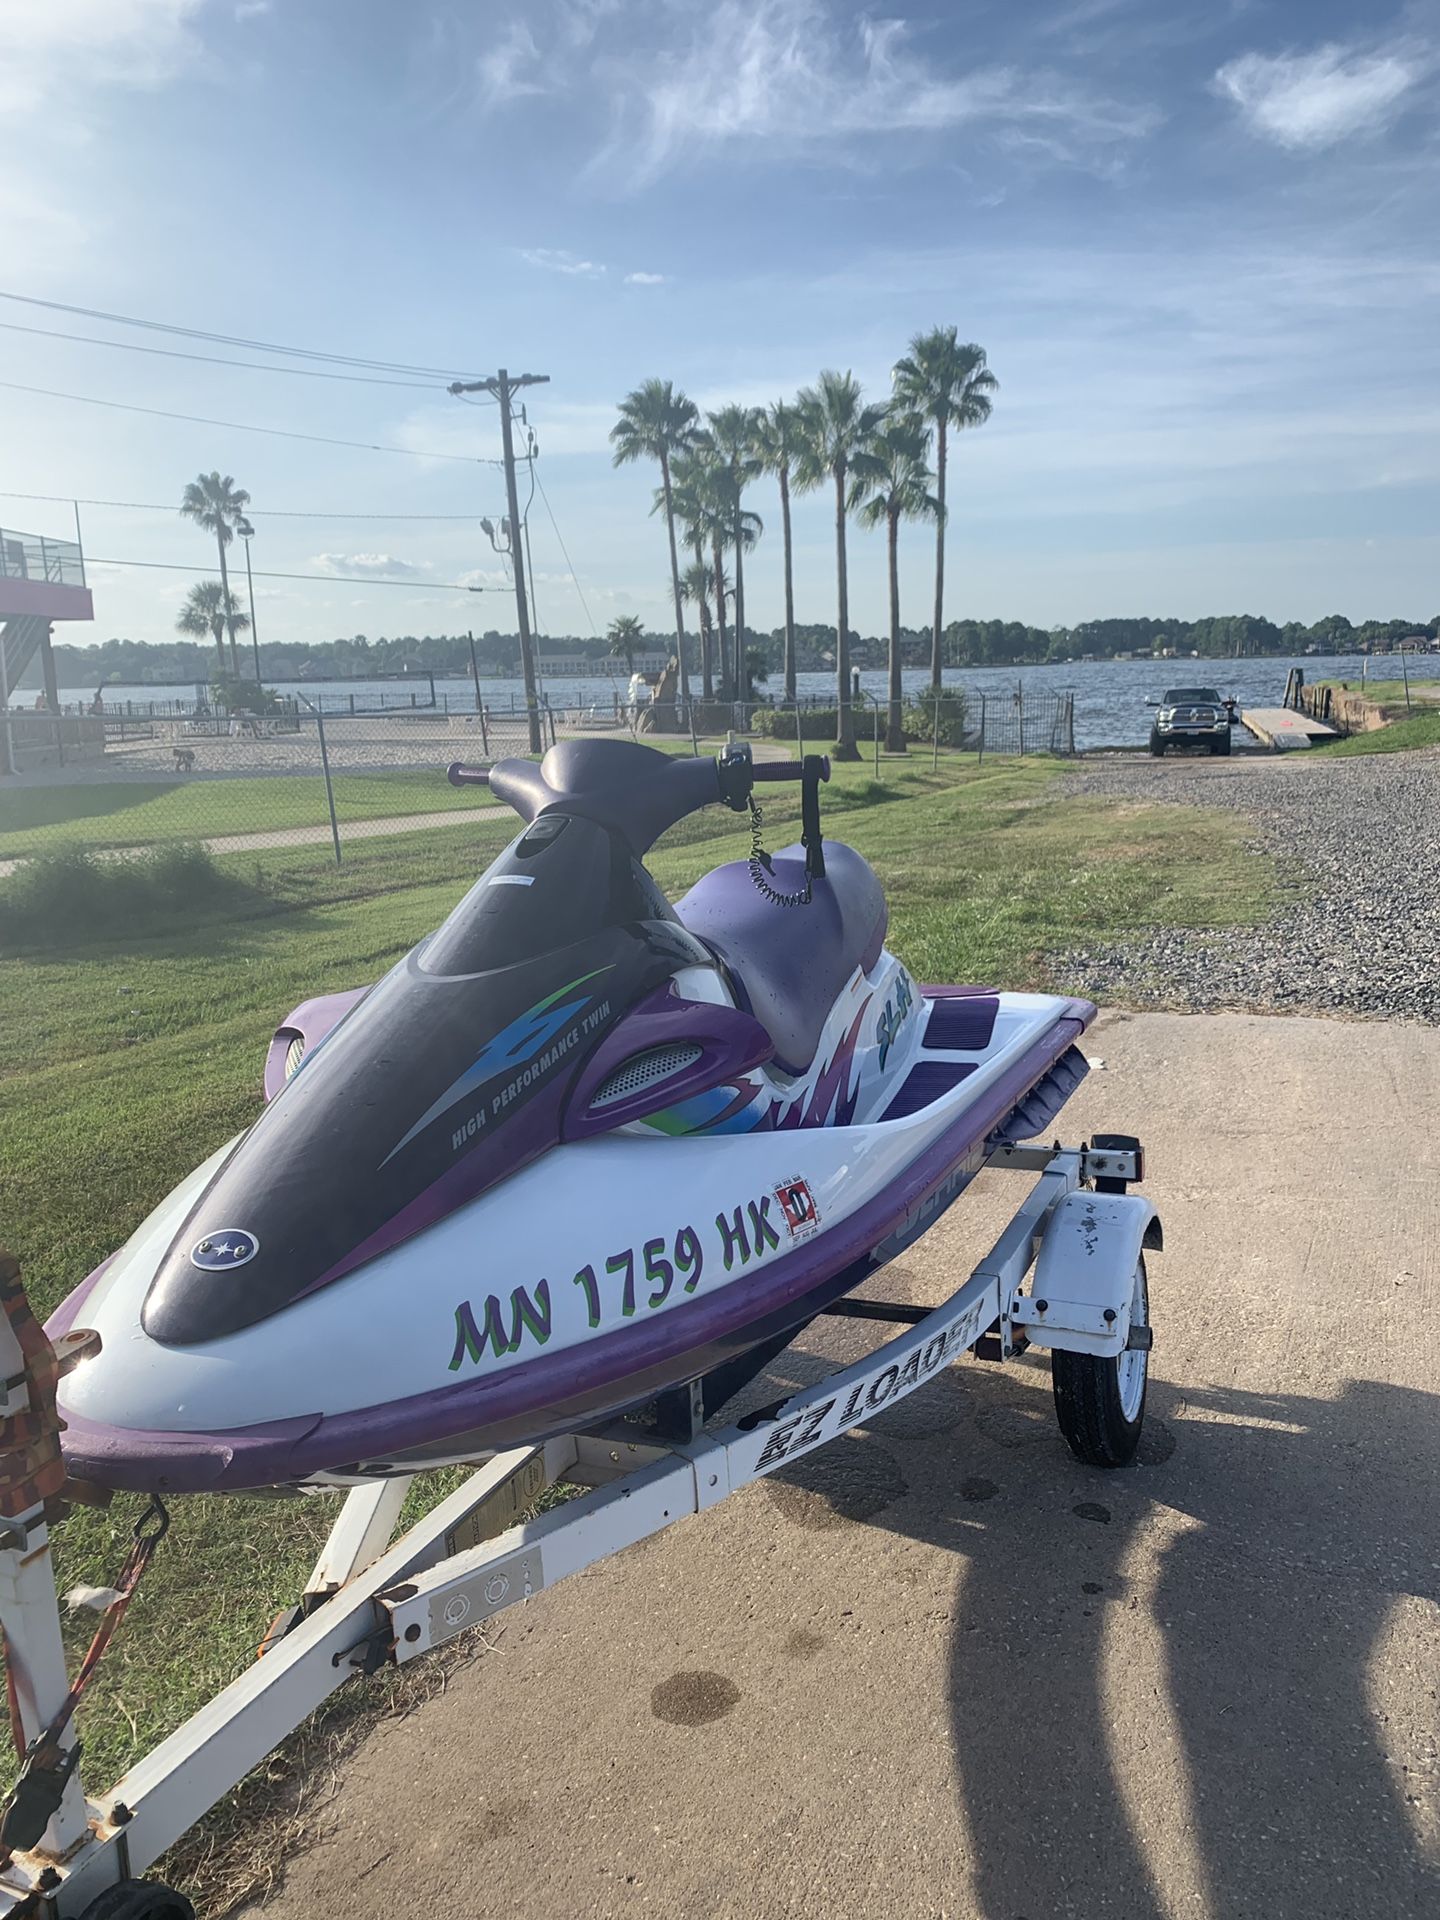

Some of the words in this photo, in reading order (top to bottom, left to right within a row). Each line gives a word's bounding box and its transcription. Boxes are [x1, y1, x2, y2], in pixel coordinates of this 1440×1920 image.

[452, 1109, 487, 1151] HIGH
[492, 1028, 580, 1115] PERFORMANCE
[581, 1000, 611, 1035] TWIN
[448, 1279, 552, 1371] MN
[573, 1225, 704, 1328] 1759
[715, 1195, 780, 1271] HK
[753, 1399, 836, 1473] EZ
[836, 1298, 985, 1430] LOADER
